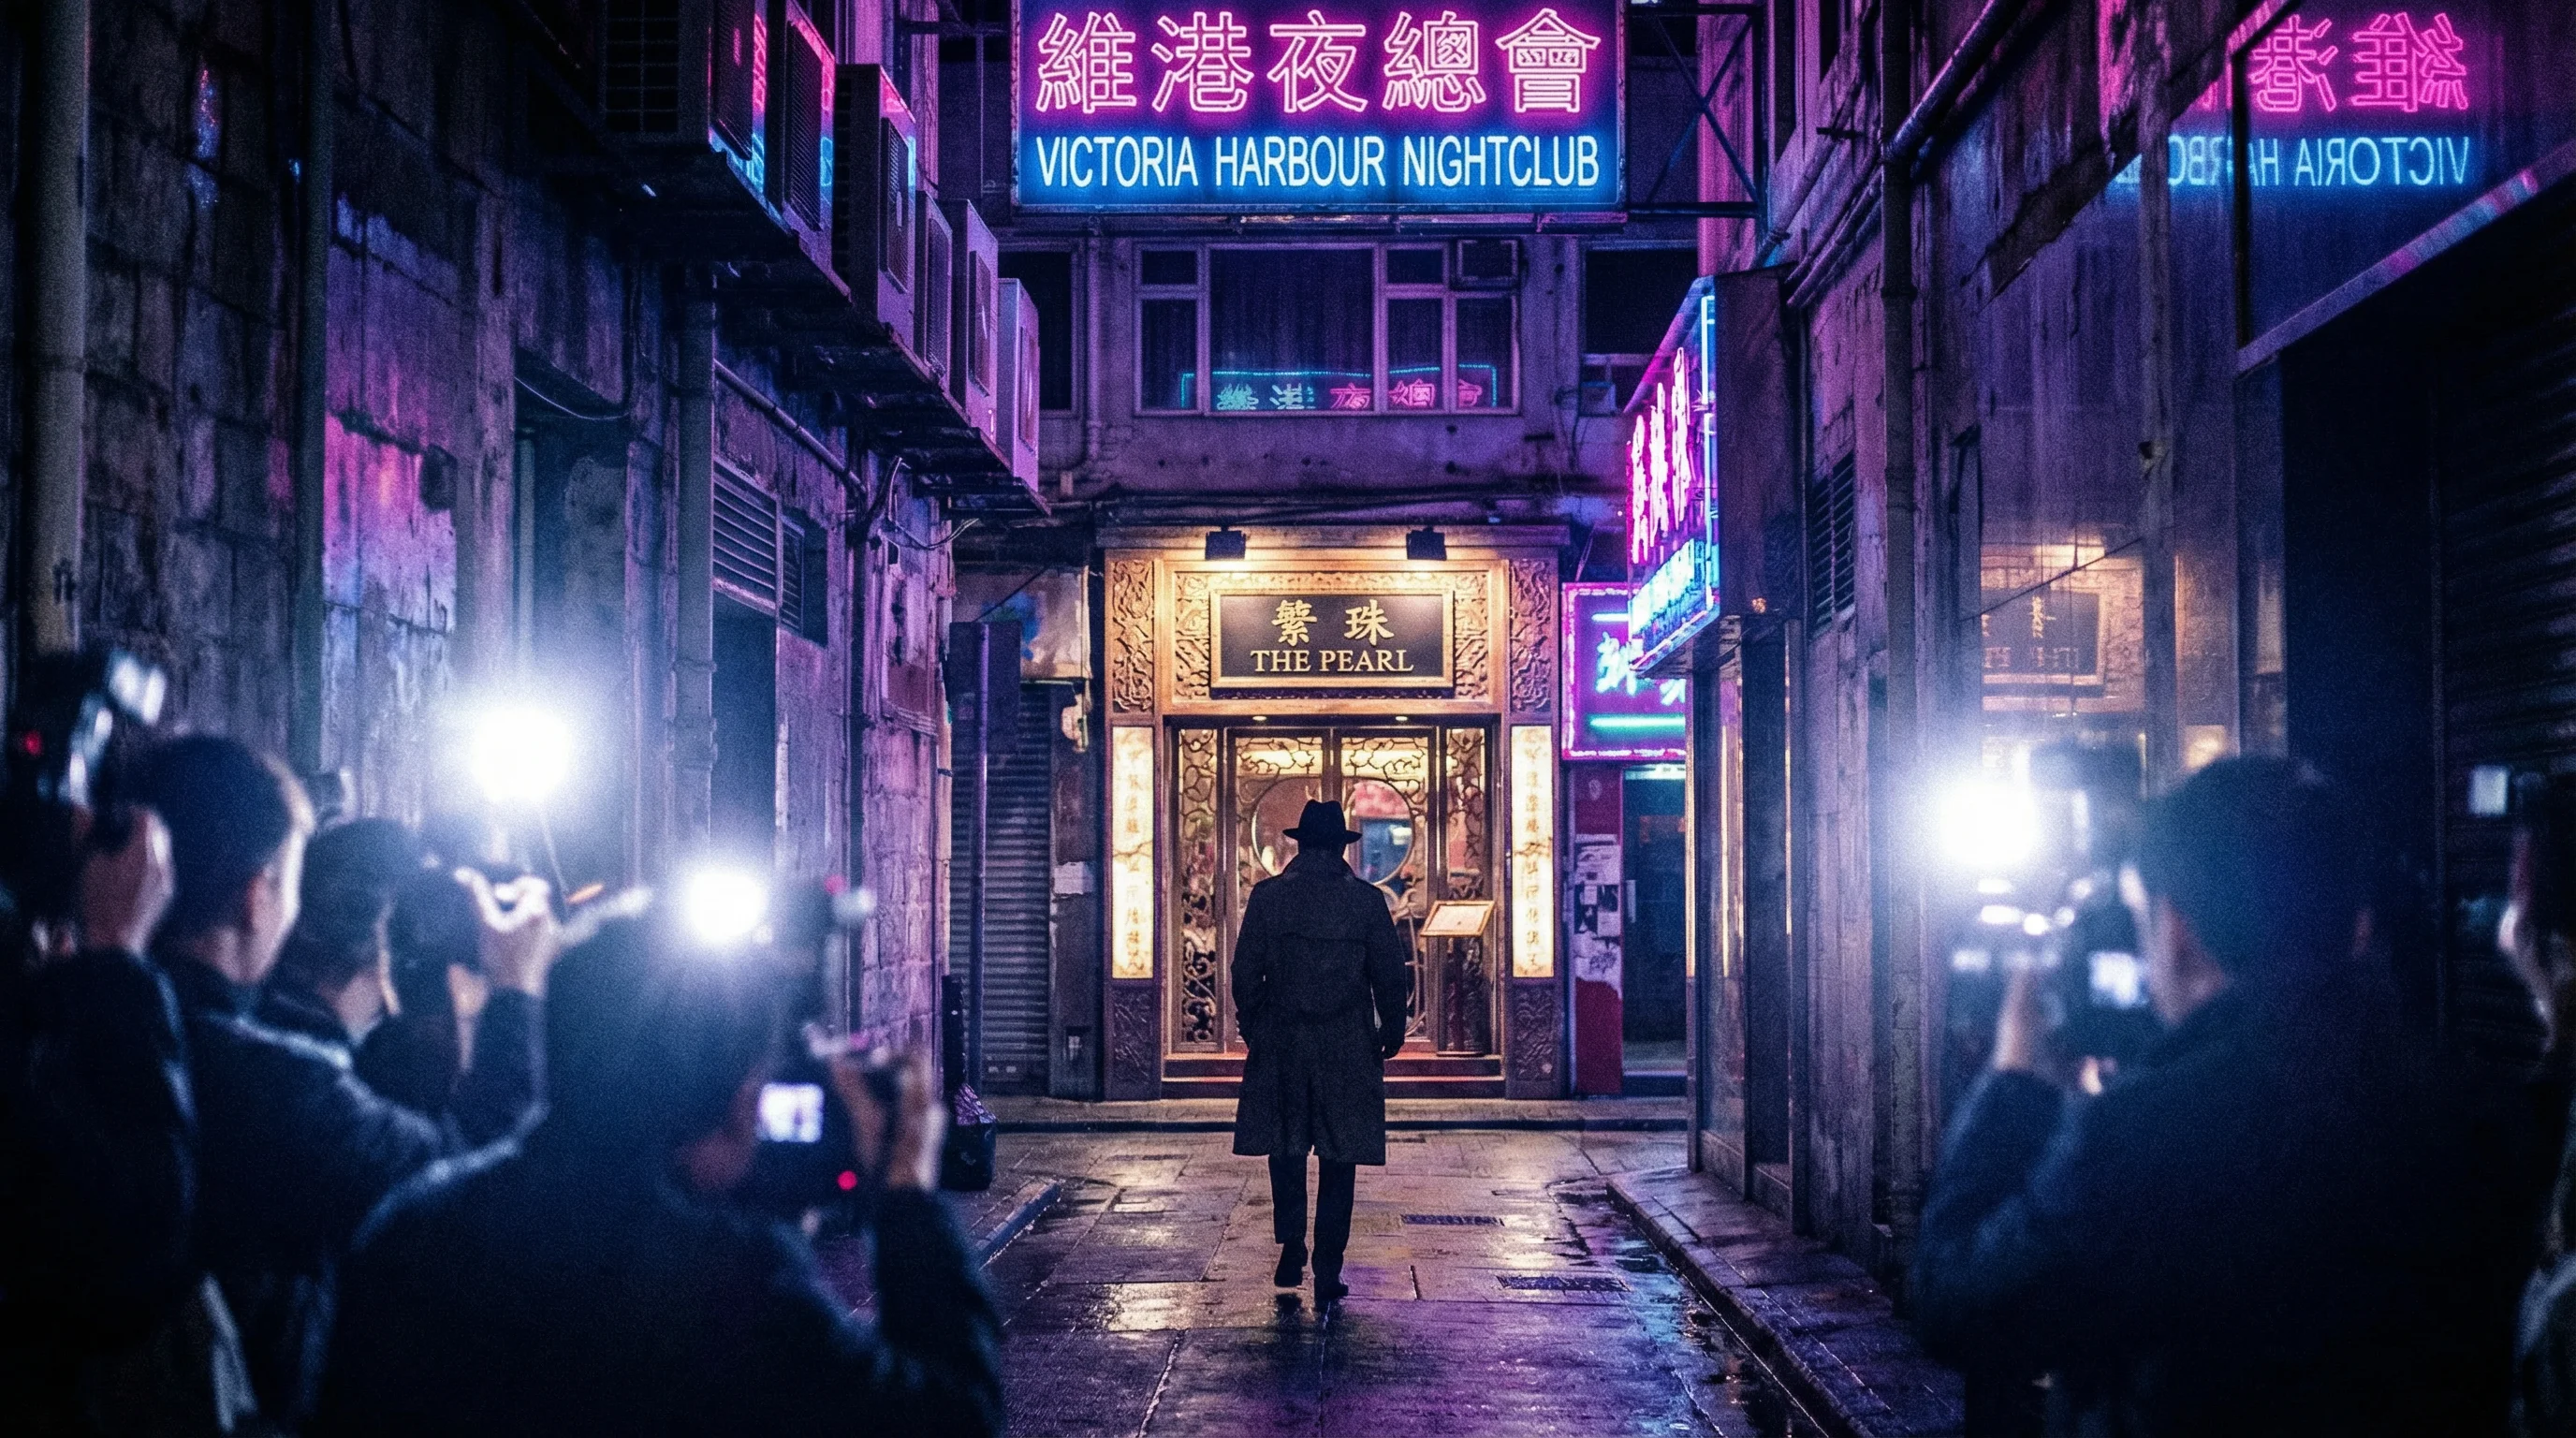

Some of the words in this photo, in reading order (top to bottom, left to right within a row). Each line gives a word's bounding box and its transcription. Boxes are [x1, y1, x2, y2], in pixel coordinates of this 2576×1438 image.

[1036, 8, 1602, 113] 維港夜總會
[1036, 136, 1199, 188] VICTORIA
[1216, 136, 1386, 188] HARBOUR
[1404, 135, 1600, 188] NIGHTCLUB
[1250, 650, 1311, 672] THE
[1319, 650, 1414, 672] PEARL
